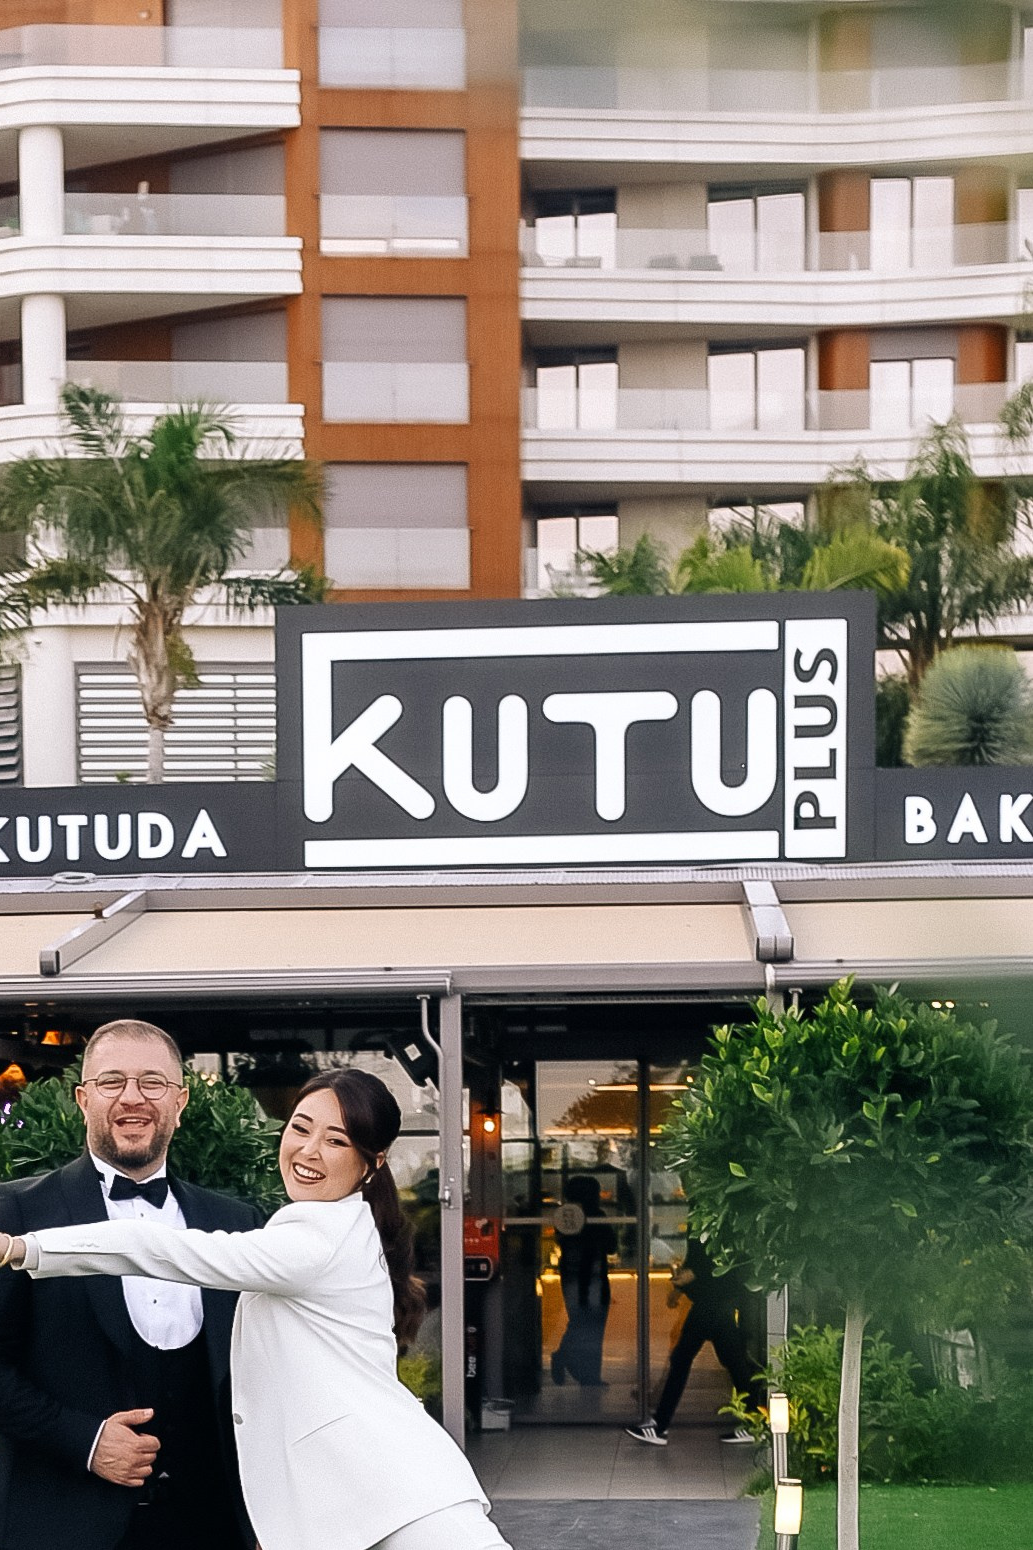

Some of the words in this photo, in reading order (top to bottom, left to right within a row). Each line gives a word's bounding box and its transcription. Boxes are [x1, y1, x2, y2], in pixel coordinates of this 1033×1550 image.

[302, 688, 777, 823] KUTU
[794, 648, 838, 830] PLUS
[904, 792, 1033, 844] BAK
